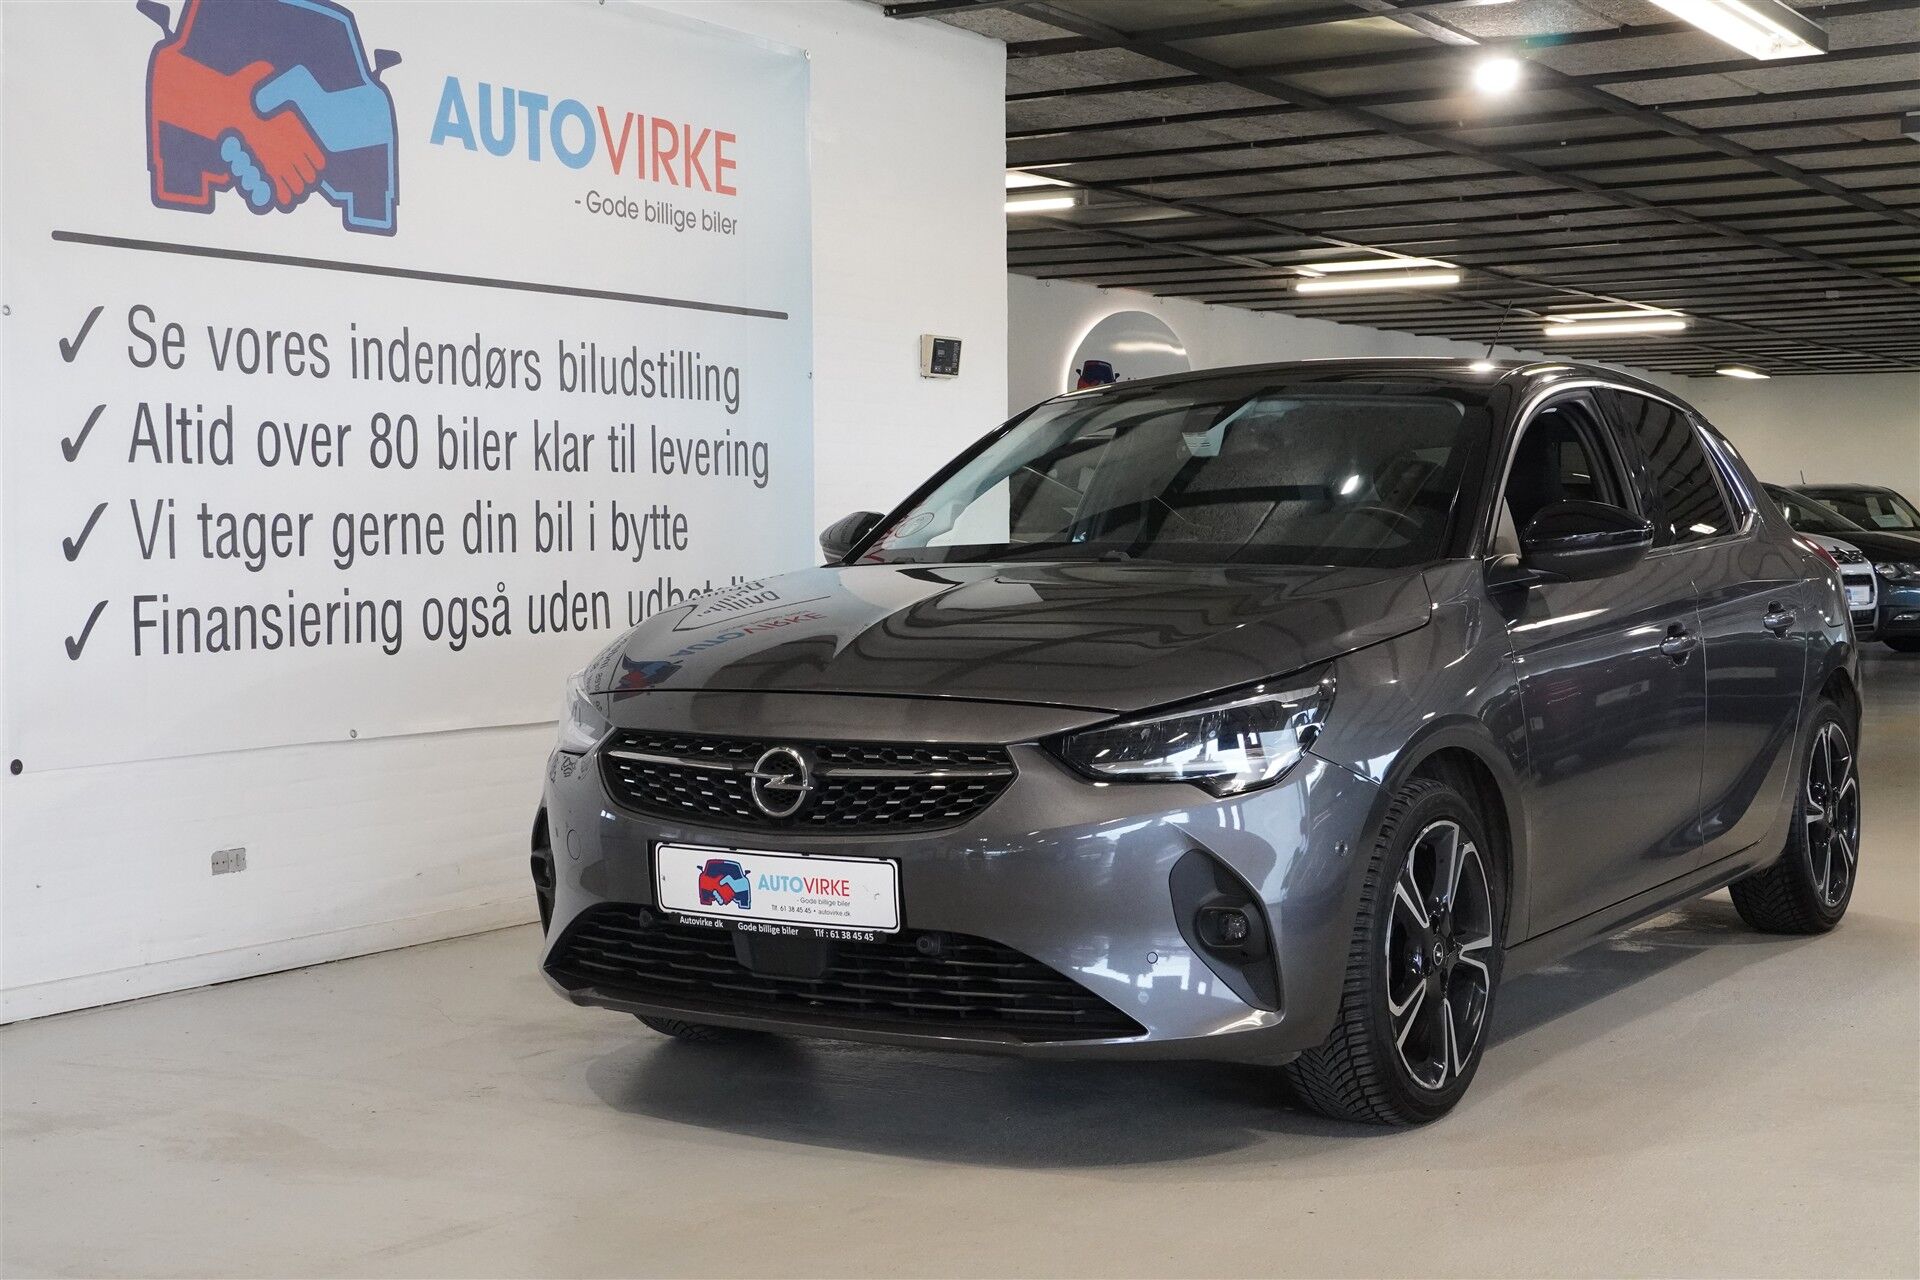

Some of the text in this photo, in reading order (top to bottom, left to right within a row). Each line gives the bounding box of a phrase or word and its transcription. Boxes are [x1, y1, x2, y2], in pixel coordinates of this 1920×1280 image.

[430, 76, 737, 197] AUTOVIRKE
[586, 190, 638, 219] Gode
[644, 198, 697, 232] billige
[701, 208, 738, 235] biler
[127, 304, 740, 415] Se vores indendørs biludstilling
[128, 402, 769, 489] Altid over 80 biler klar til levering
[129, 498, 688, 573] Vi tager gerne din bil i bytte
[133, 586, 403, 657] Finansiering
[422, 580, 512, 652] også
[528, 579, 611, 635] uden
[757, 873, 850, 897] AUTOVIRKE
[737, 922, 757, 932] Gode
[758, 924, 780, 935] billige
[781, 926, 799, 936] biler
[830, 930, 840, 939] 61
[841, 931, 851, 940] 38
[852, 932, 863, 941] 45
[864, 933, 875, 942] 45
